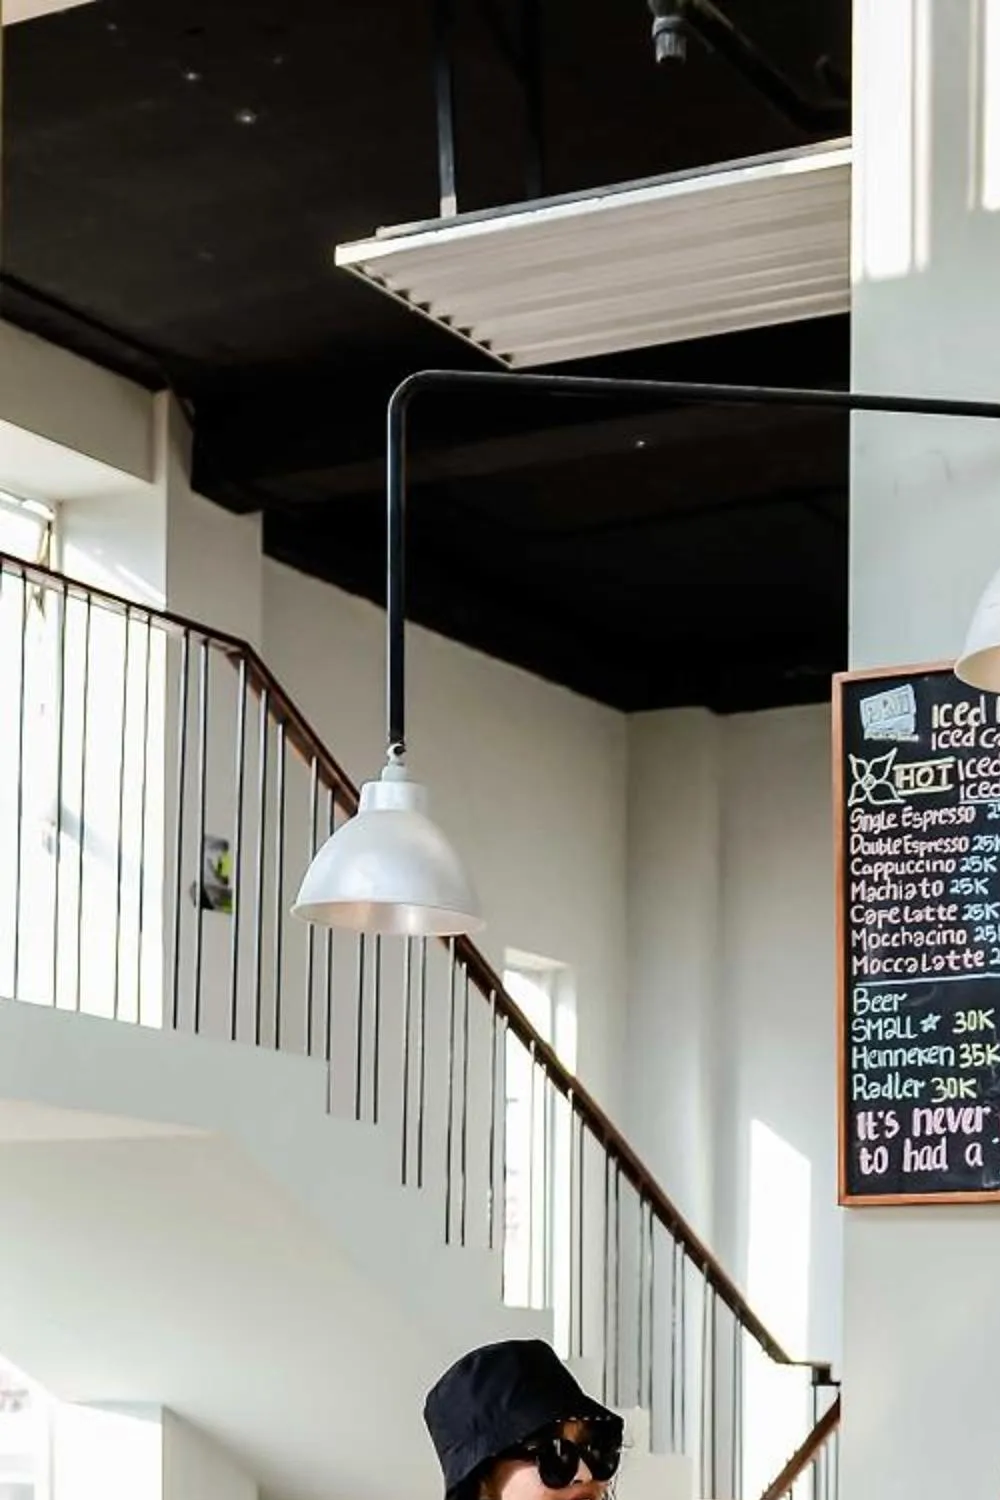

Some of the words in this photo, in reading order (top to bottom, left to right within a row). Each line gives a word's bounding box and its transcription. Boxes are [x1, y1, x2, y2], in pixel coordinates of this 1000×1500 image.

[894, 763, 954, 789] HOT
[901, 805, 977, 832] Espresso
[902, 834, 970, 857] Espresso
[959, 855, 998, 873] 25K
[949, 877, 990, 895] 25K
[961, 902, 1000, 921] 25K
[853, 987, 908, 1016] Beer
[952, 1008, 996, 1034] 30K
[852, 1071, 926, 1101] Radler
[931, 1077, 978, 1103] 30K
[912, 1104, 991, 1137] never
[859, 1147, 889, 1175] to
[903, 1138, 948, 1173] had
[965, 1142, 984, 1168] a
